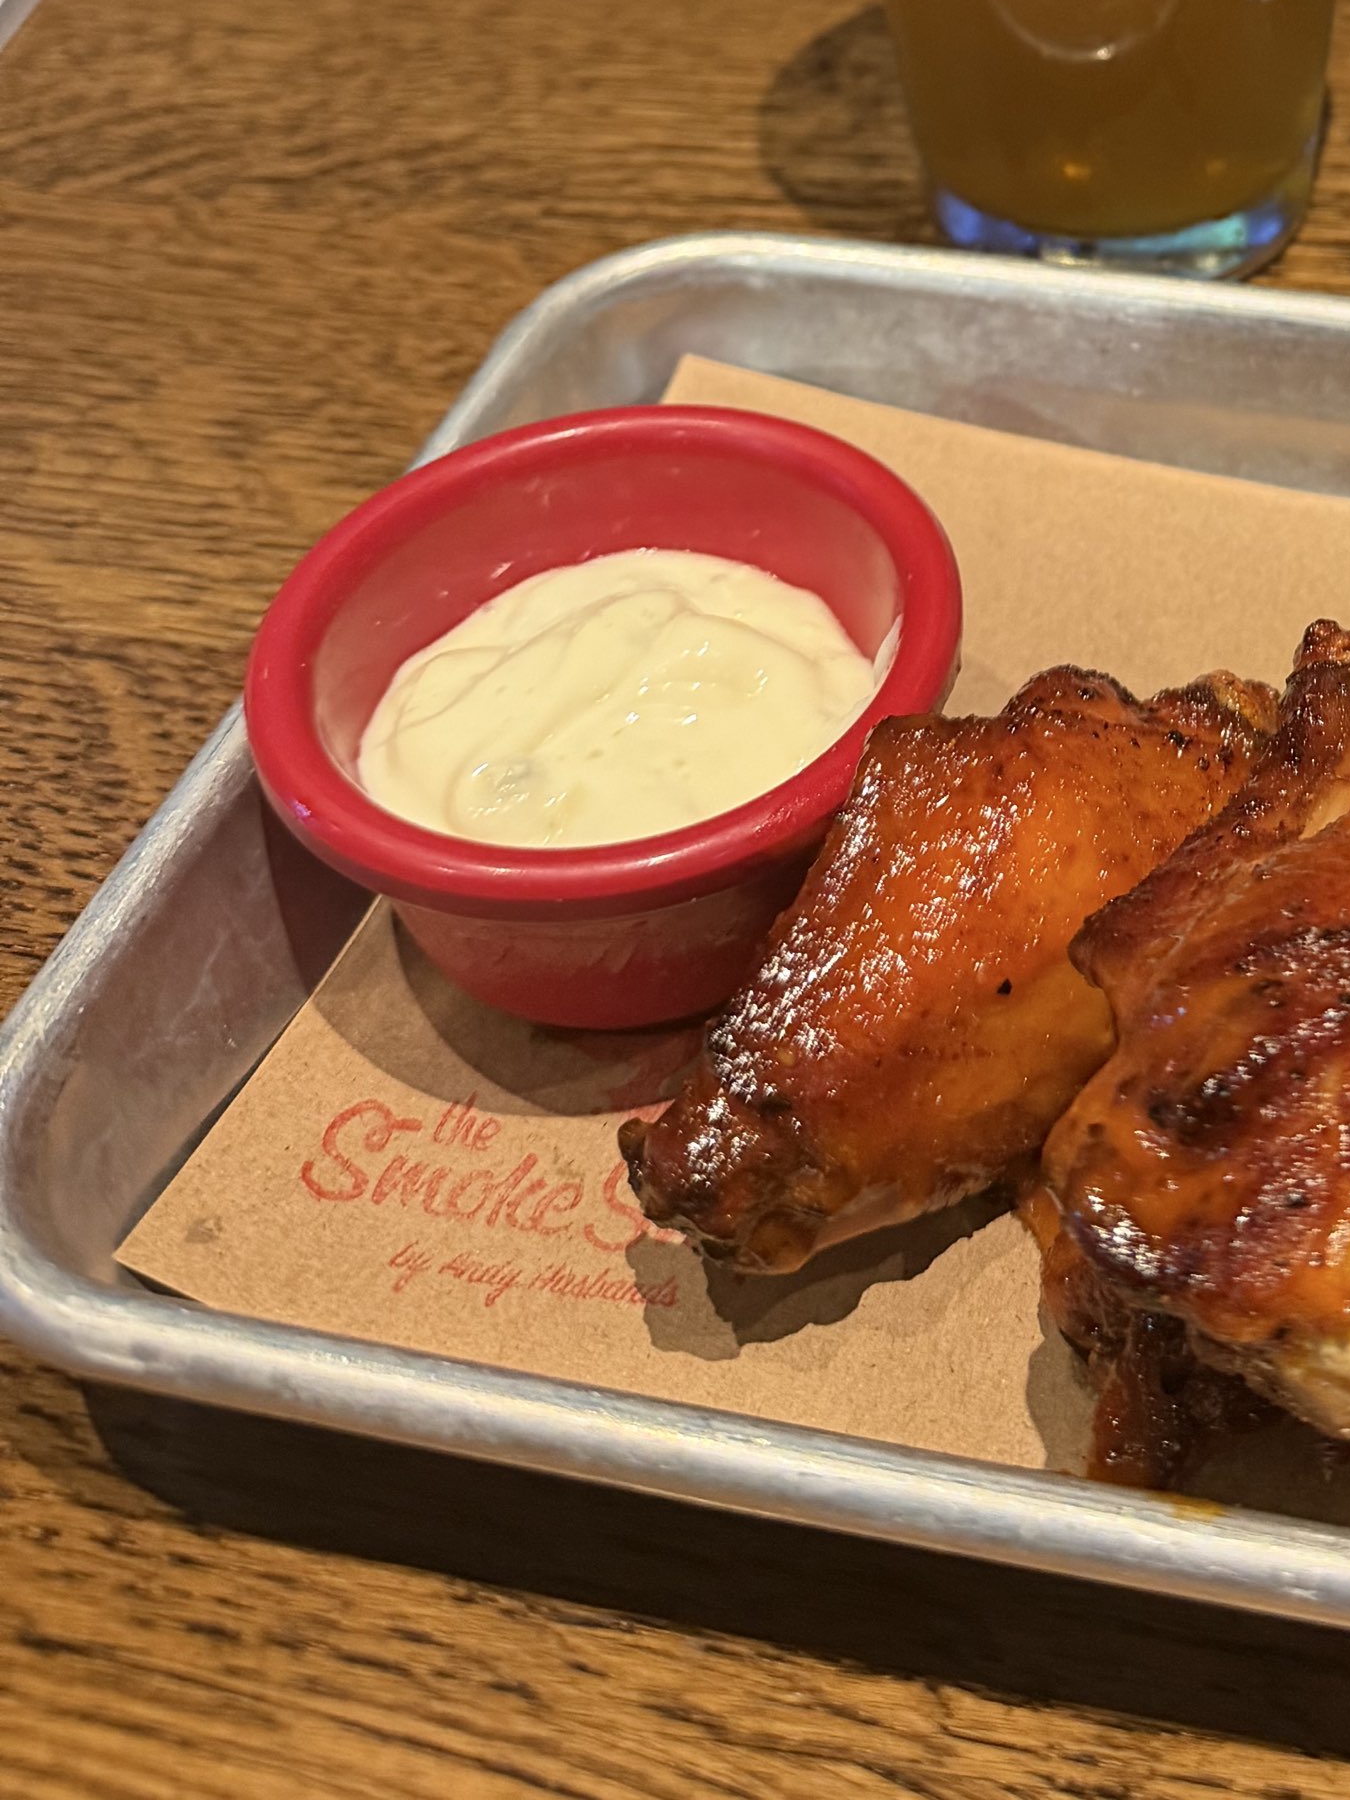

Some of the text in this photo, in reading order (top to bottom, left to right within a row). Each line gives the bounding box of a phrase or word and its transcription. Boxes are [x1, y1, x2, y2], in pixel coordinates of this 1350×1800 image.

[433, 1090, 501, 1152] the
[300, 1099, 585, 1234] Smoke
[388, 1239, 433, 1293] by
[438, 1252, 523, 1308] Andy
